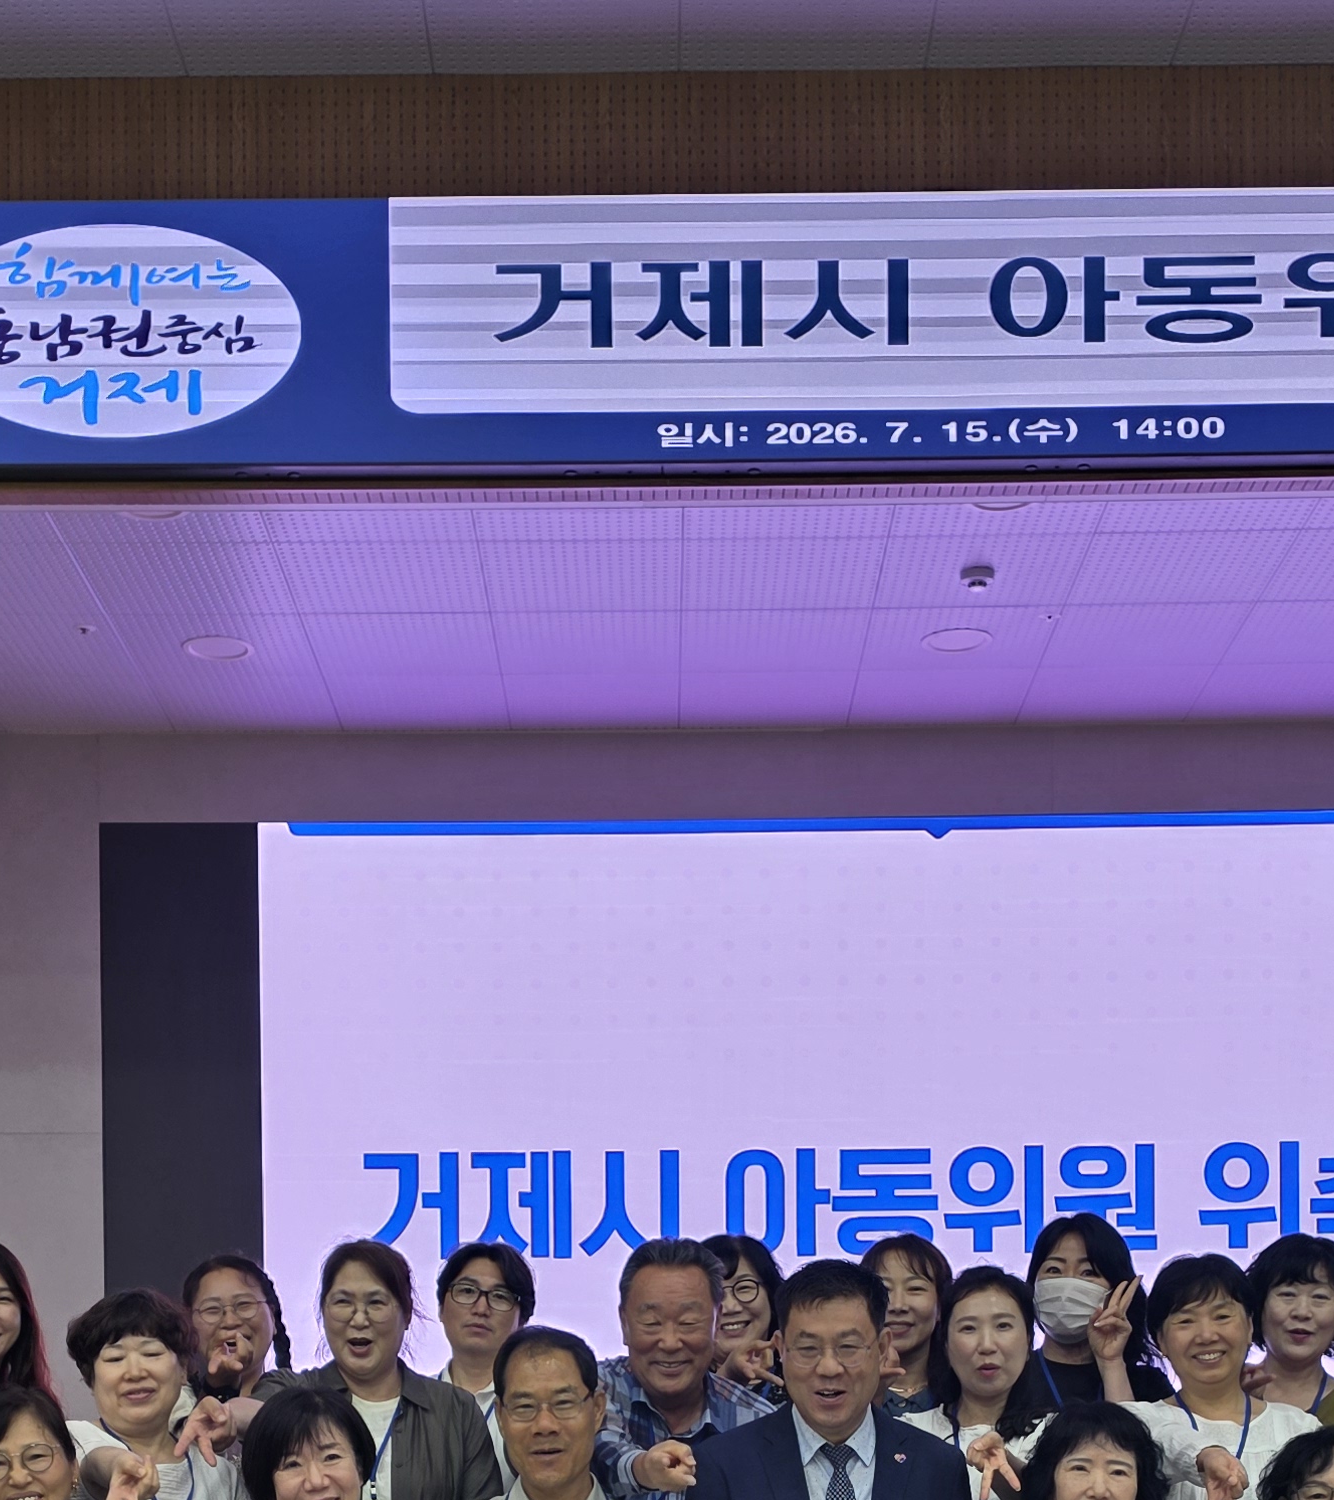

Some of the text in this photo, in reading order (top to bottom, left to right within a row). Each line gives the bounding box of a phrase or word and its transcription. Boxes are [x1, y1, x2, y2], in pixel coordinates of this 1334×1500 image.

[493, 258, 909, 348] 거제시
[18, 369, 202, 425] 거제
[657, 421, 748, 448] 일시:
[766, 422, 868, 446] 2026.
[885, 422, 923, 444] 7.
[1111, 417, 1226, 441] 14:00
[363, 1149, 680, 1260] 거제시
[725, 1143, 1158, 1257] 아동위원
